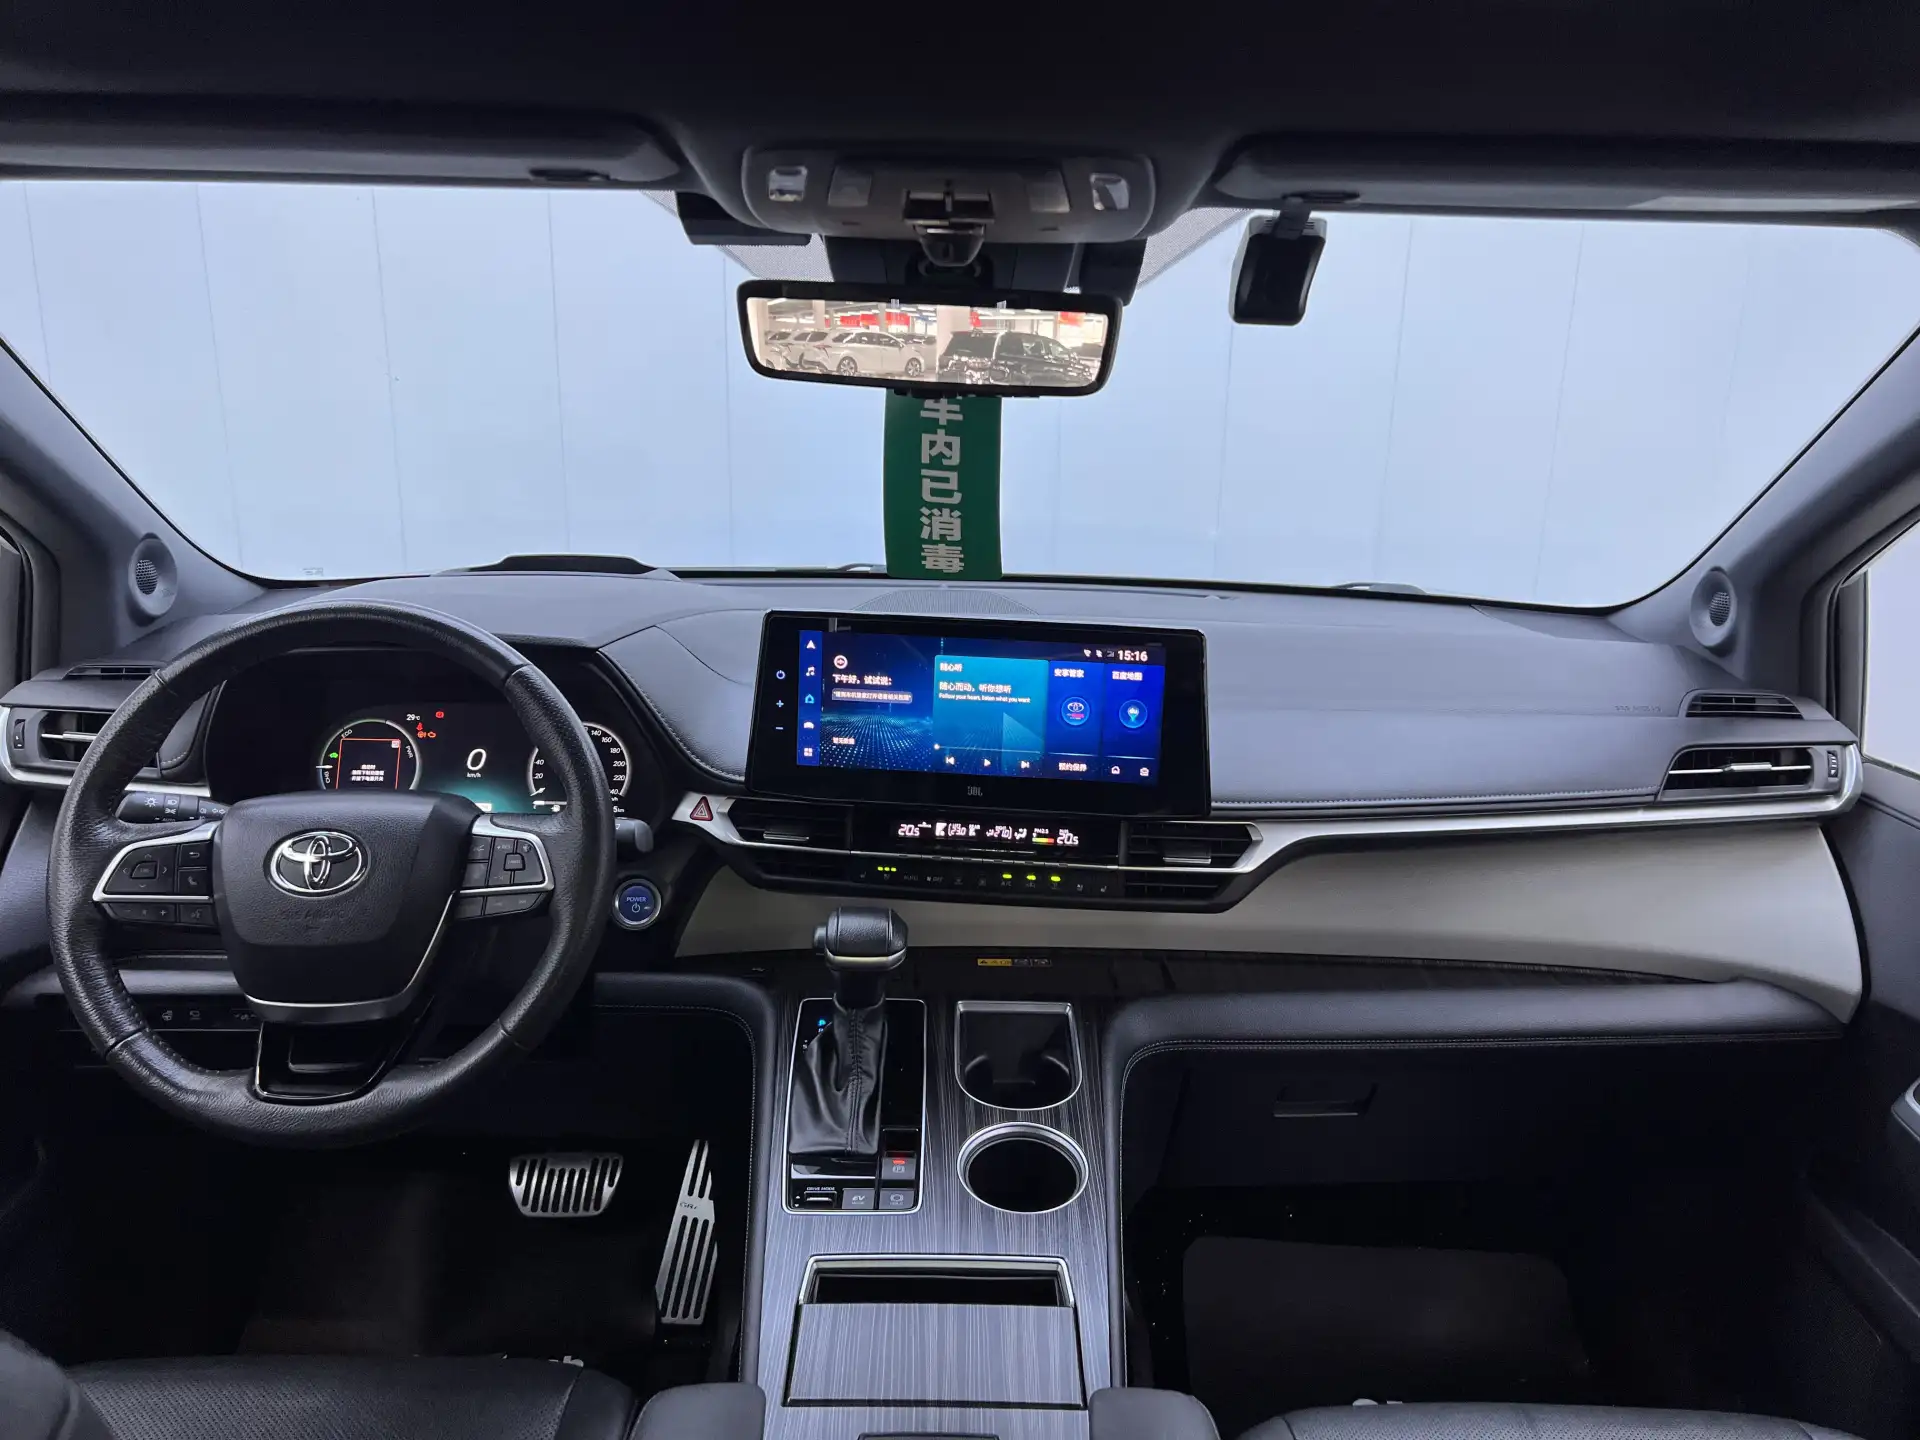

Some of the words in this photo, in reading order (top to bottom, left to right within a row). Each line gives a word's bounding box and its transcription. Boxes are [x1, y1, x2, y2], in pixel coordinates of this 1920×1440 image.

[919, 398, 964, 573] 车内已消毒
[1118, 650, 1148, 661] 15:16
[939, 662, 963, 672] 随心听
[1112, 670, 1143, 681] 百度地图
[466, 748, 487, 771] 0
